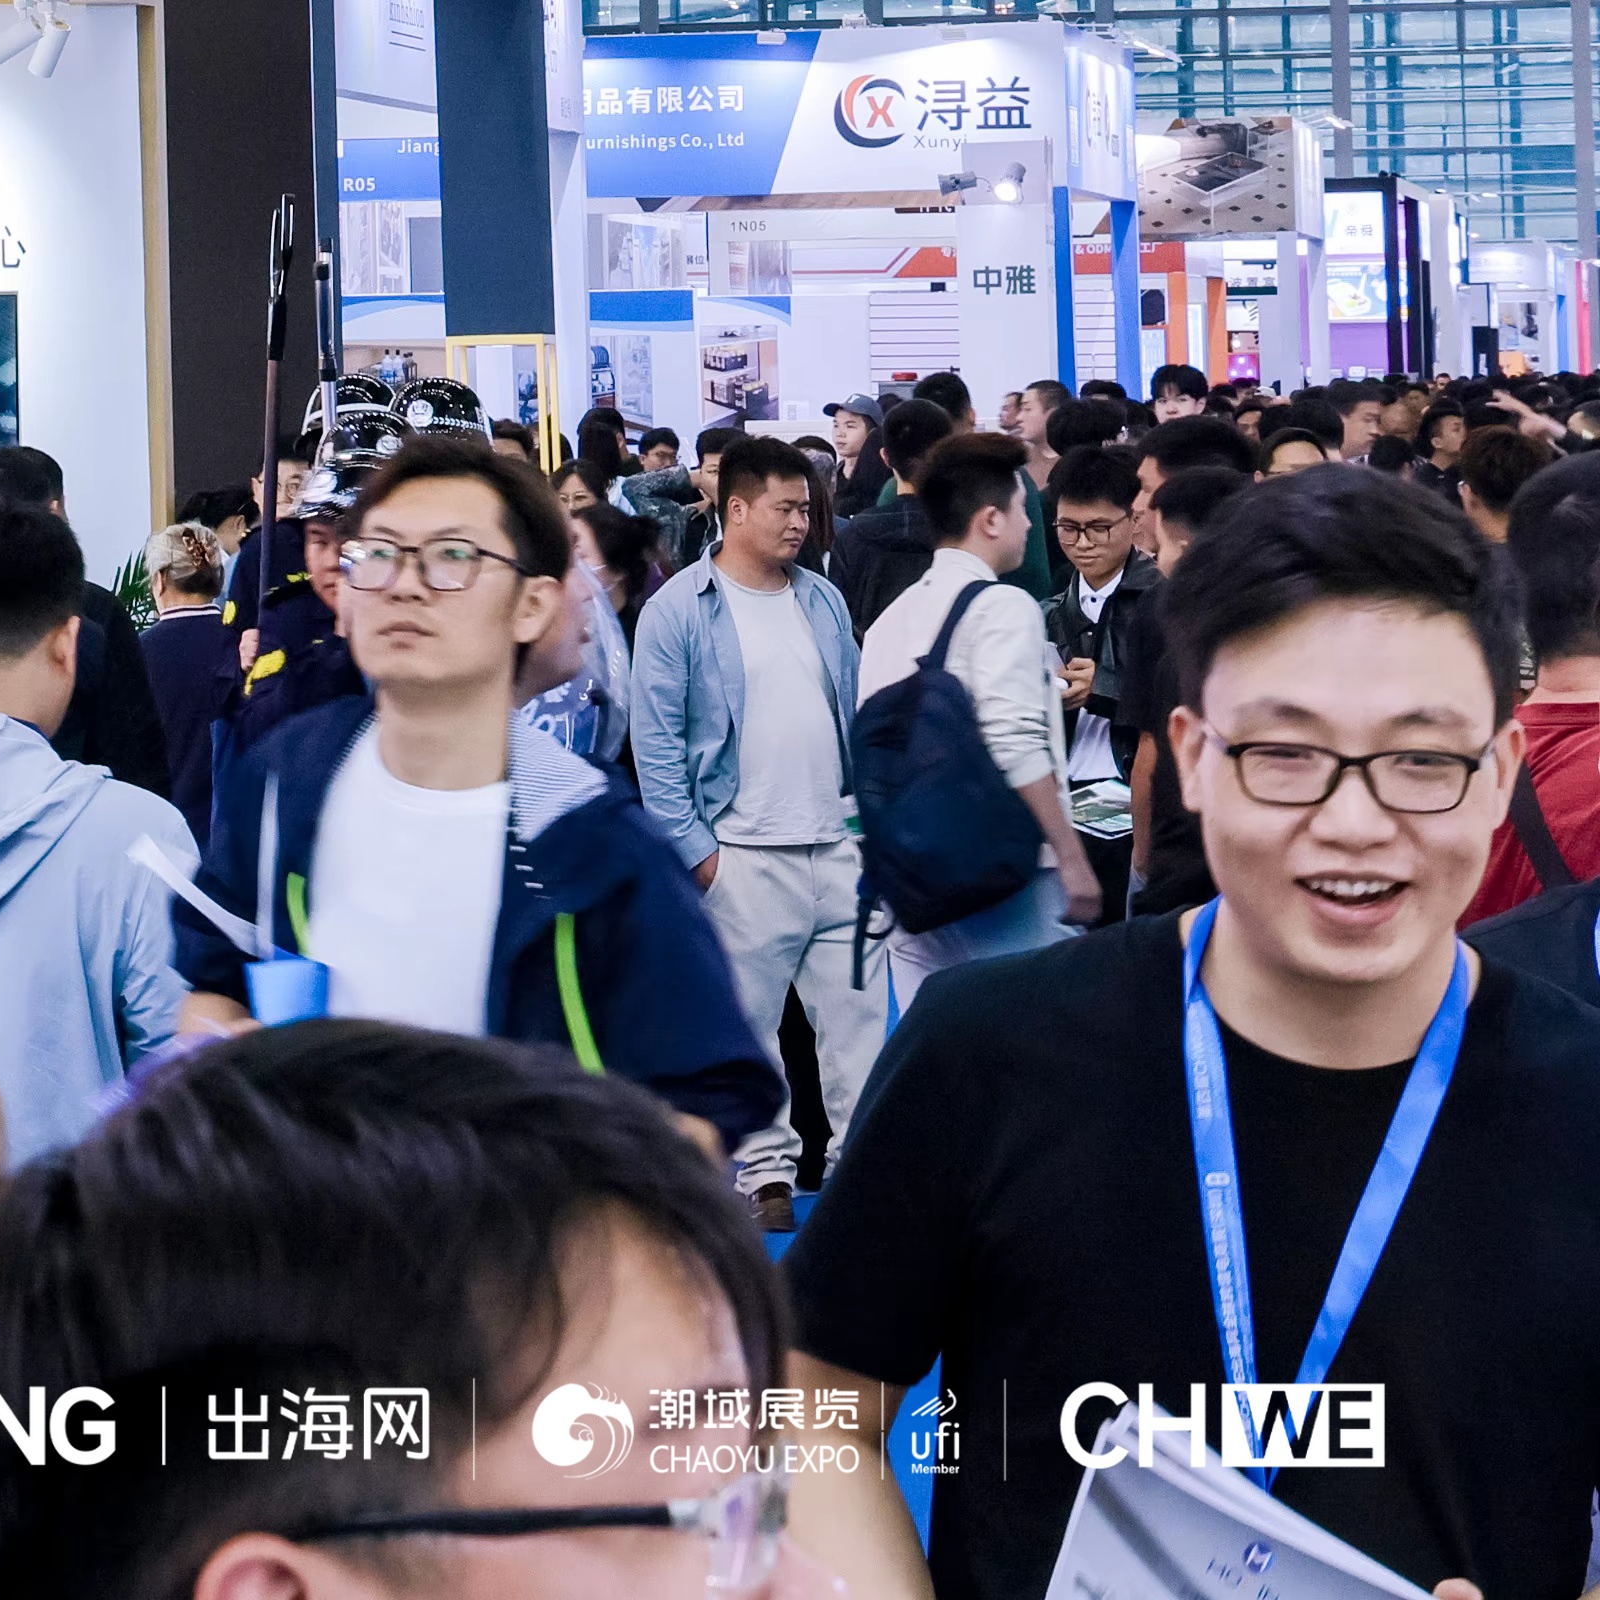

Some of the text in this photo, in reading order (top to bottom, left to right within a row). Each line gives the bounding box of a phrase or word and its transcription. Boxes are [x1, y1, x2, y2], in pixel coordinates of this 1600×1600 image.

[914, 76, 1032, 131] 浔益
[717, 132, 745, 147] Ltd
[730, 220, 767, 232] 1N05
[972, 264, 1037, 295] 中雅
